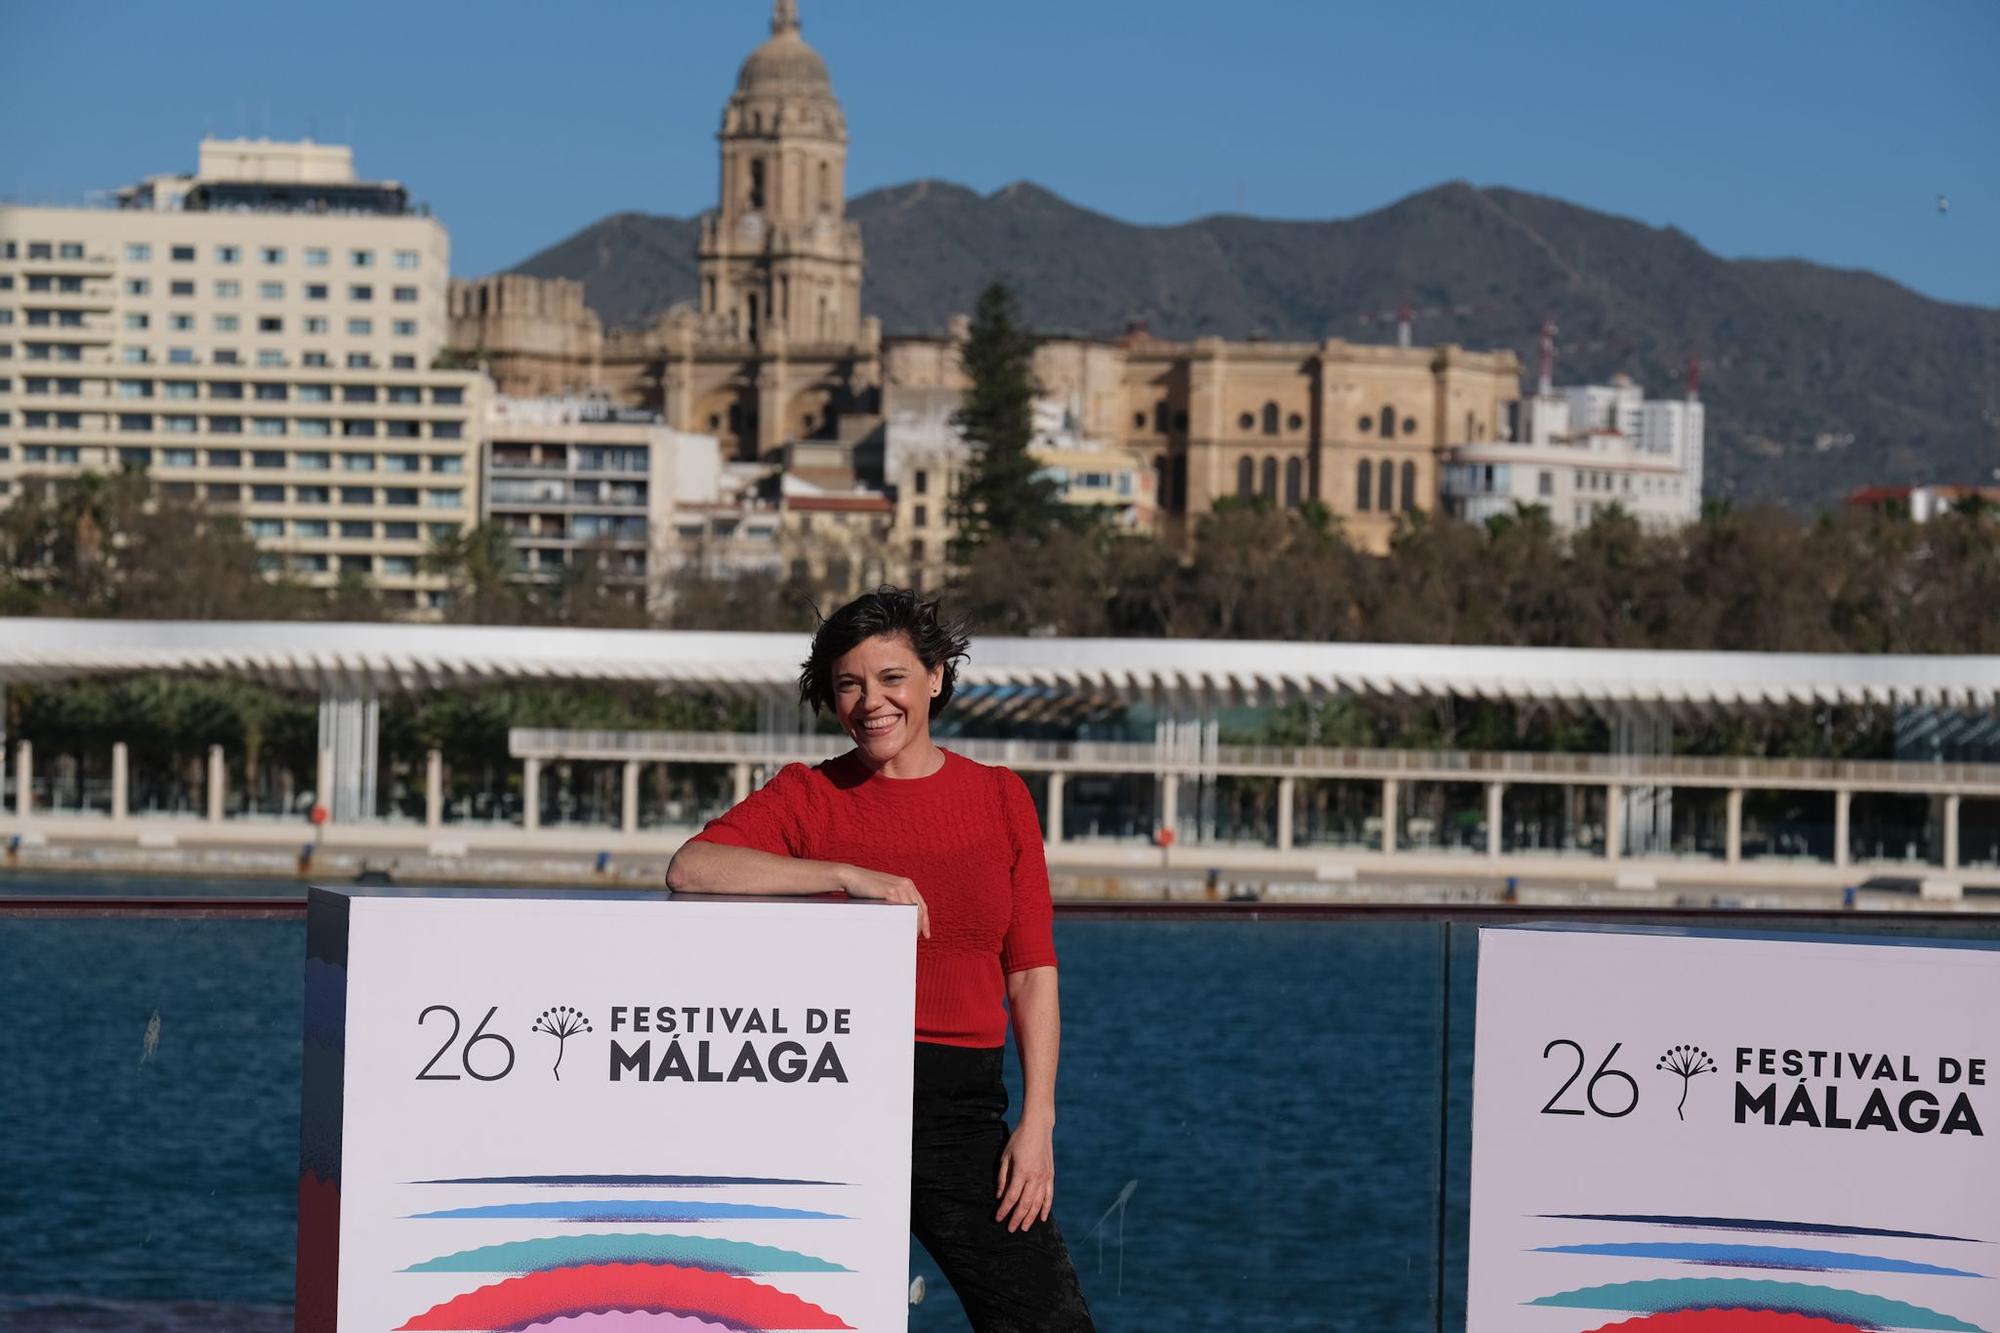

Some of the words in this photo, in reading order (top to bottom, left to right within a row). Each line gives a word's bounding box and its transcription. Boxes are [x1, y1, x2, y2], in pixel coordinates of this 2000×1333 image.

[415, 1005, 515, 1082] 26
[610, 1006, 788, 1034] FESTIVAL
[806, 1008, 851, 1035] DE
[609, 1033, 849, 1084] MÁLAGA
[1540, 1039, 1640, 1119] 26
[1735, 1046, 1920, 1083] FESTIVAL
[1938, 1056, 1987, 1086] DE
[1734, 1077, 1984, 1137] MÁLAGA
